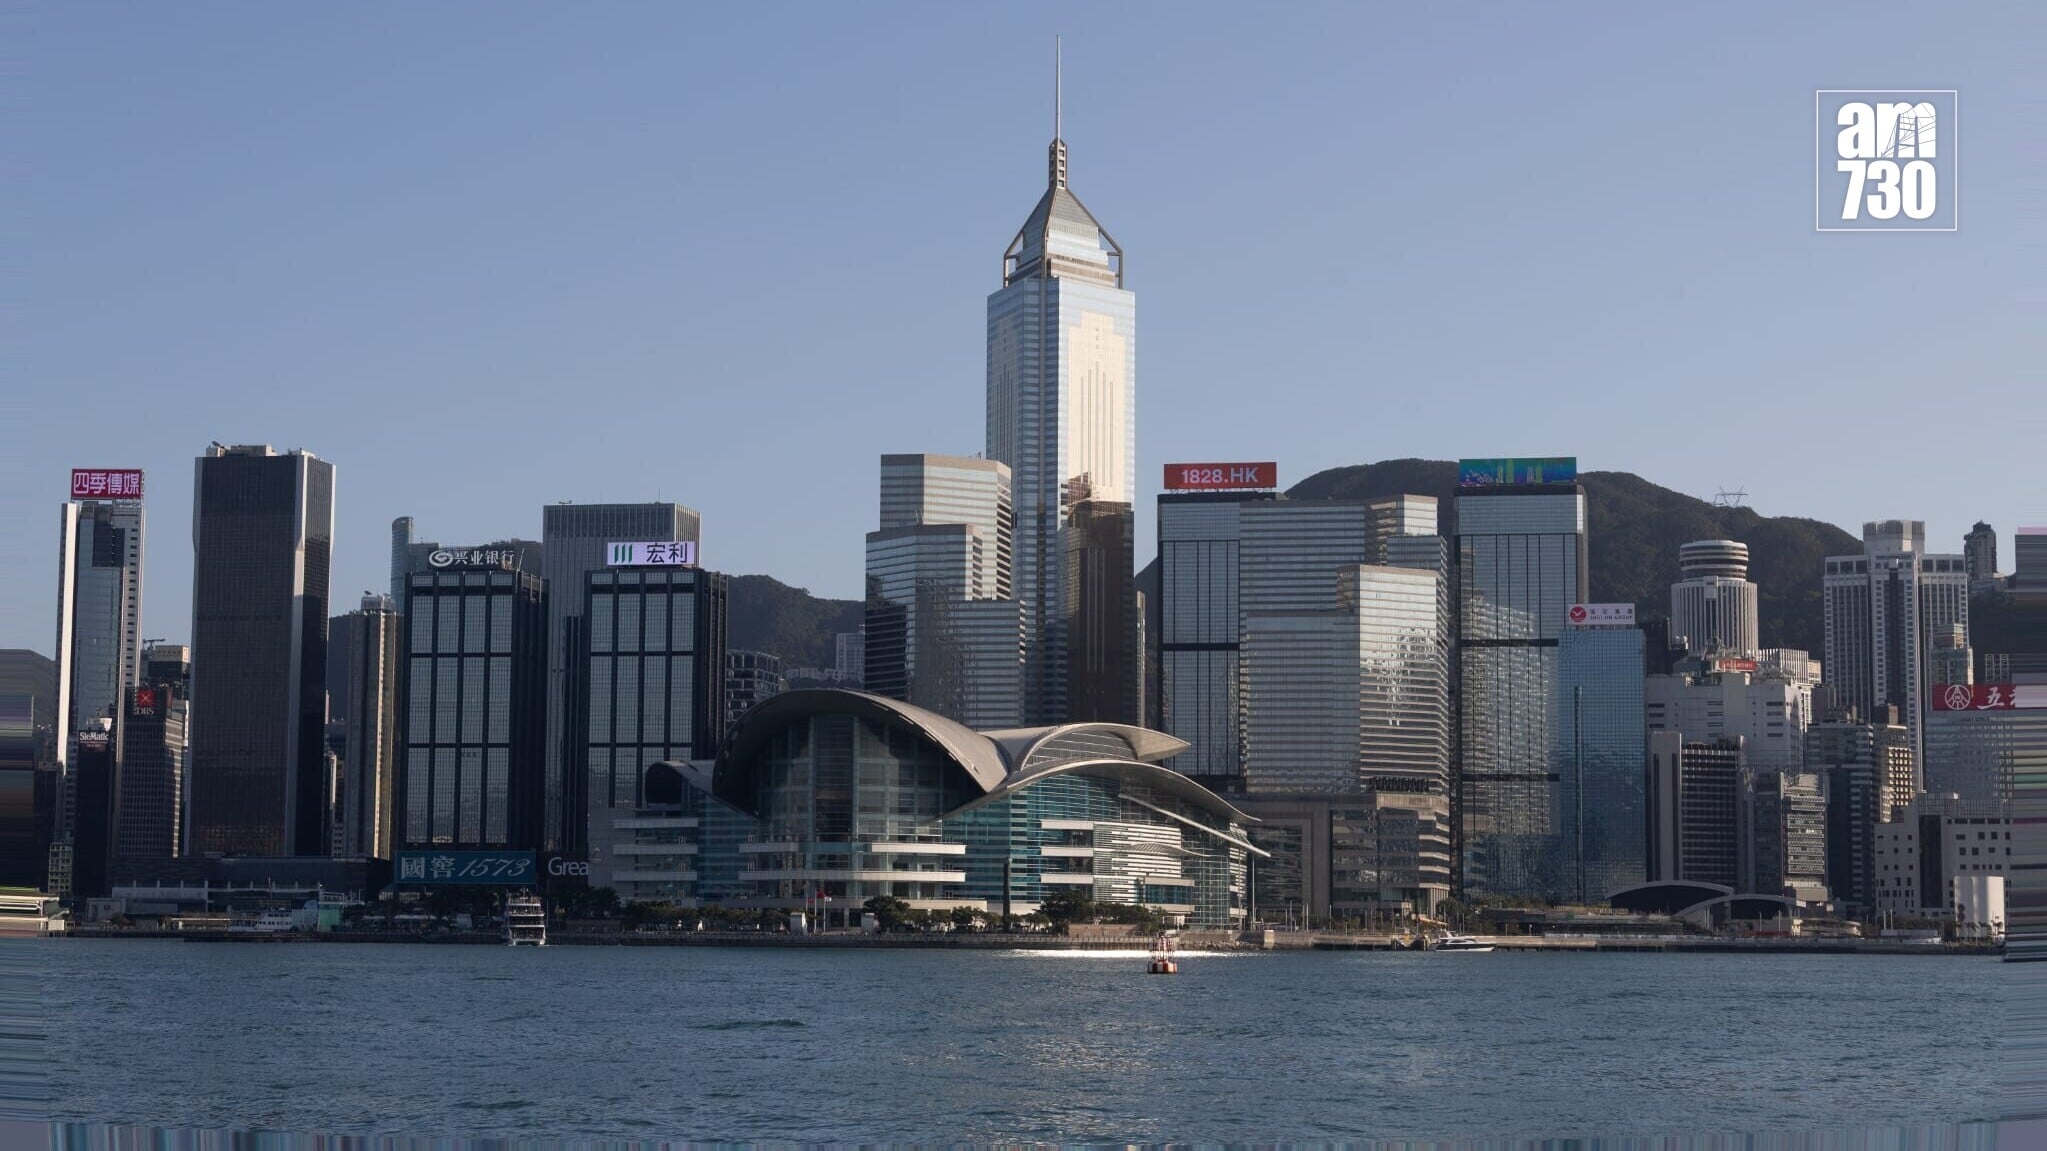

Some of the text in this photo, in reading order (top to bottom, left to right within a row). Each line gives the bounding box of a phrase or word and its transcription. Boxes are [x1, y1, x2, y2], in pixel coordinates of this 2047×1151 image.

[74, 472, 139, 495] 四季傳媒
[1182, 467, 1259, 484] 1828.HK
[454, 550, 515, 567] 兴业银行
[646, 542, 687, 563] 宏利
